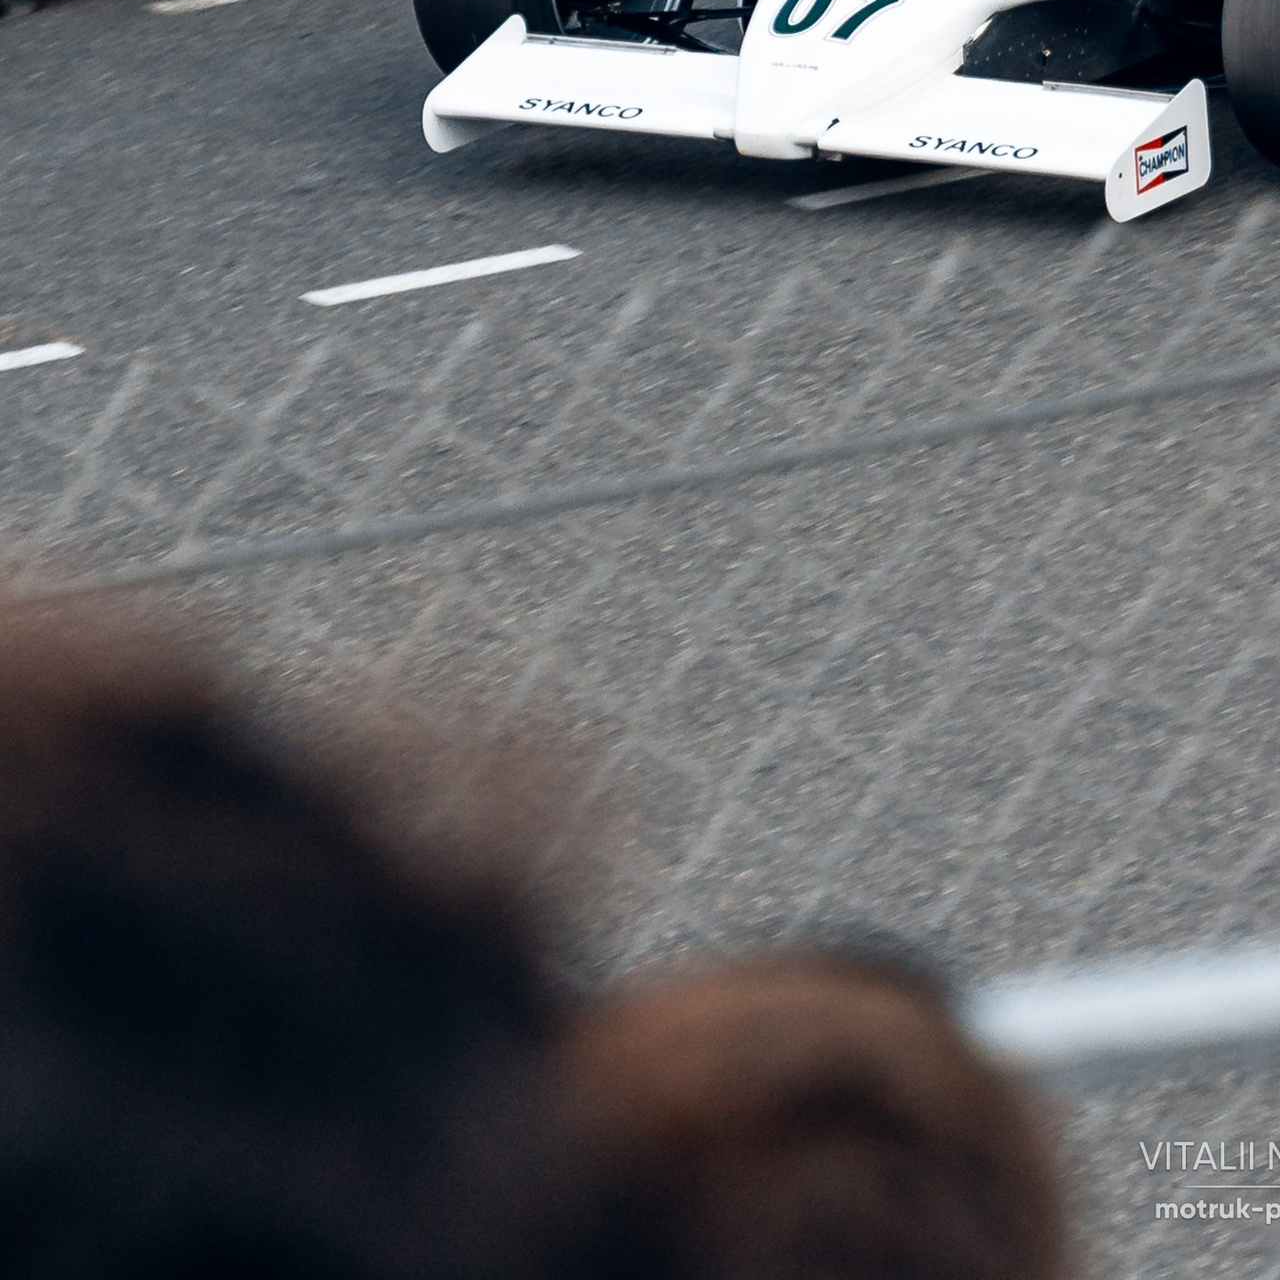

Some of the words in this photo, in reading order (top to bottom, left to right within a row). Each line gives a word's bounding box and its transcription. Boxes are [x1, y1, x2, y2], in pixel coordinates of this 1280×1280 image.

[519, 98, 643, 120] SYANCO
[909, 135, 1039, 160] SYANCO
[1139, 143, 1185, 178] CHAMPION
